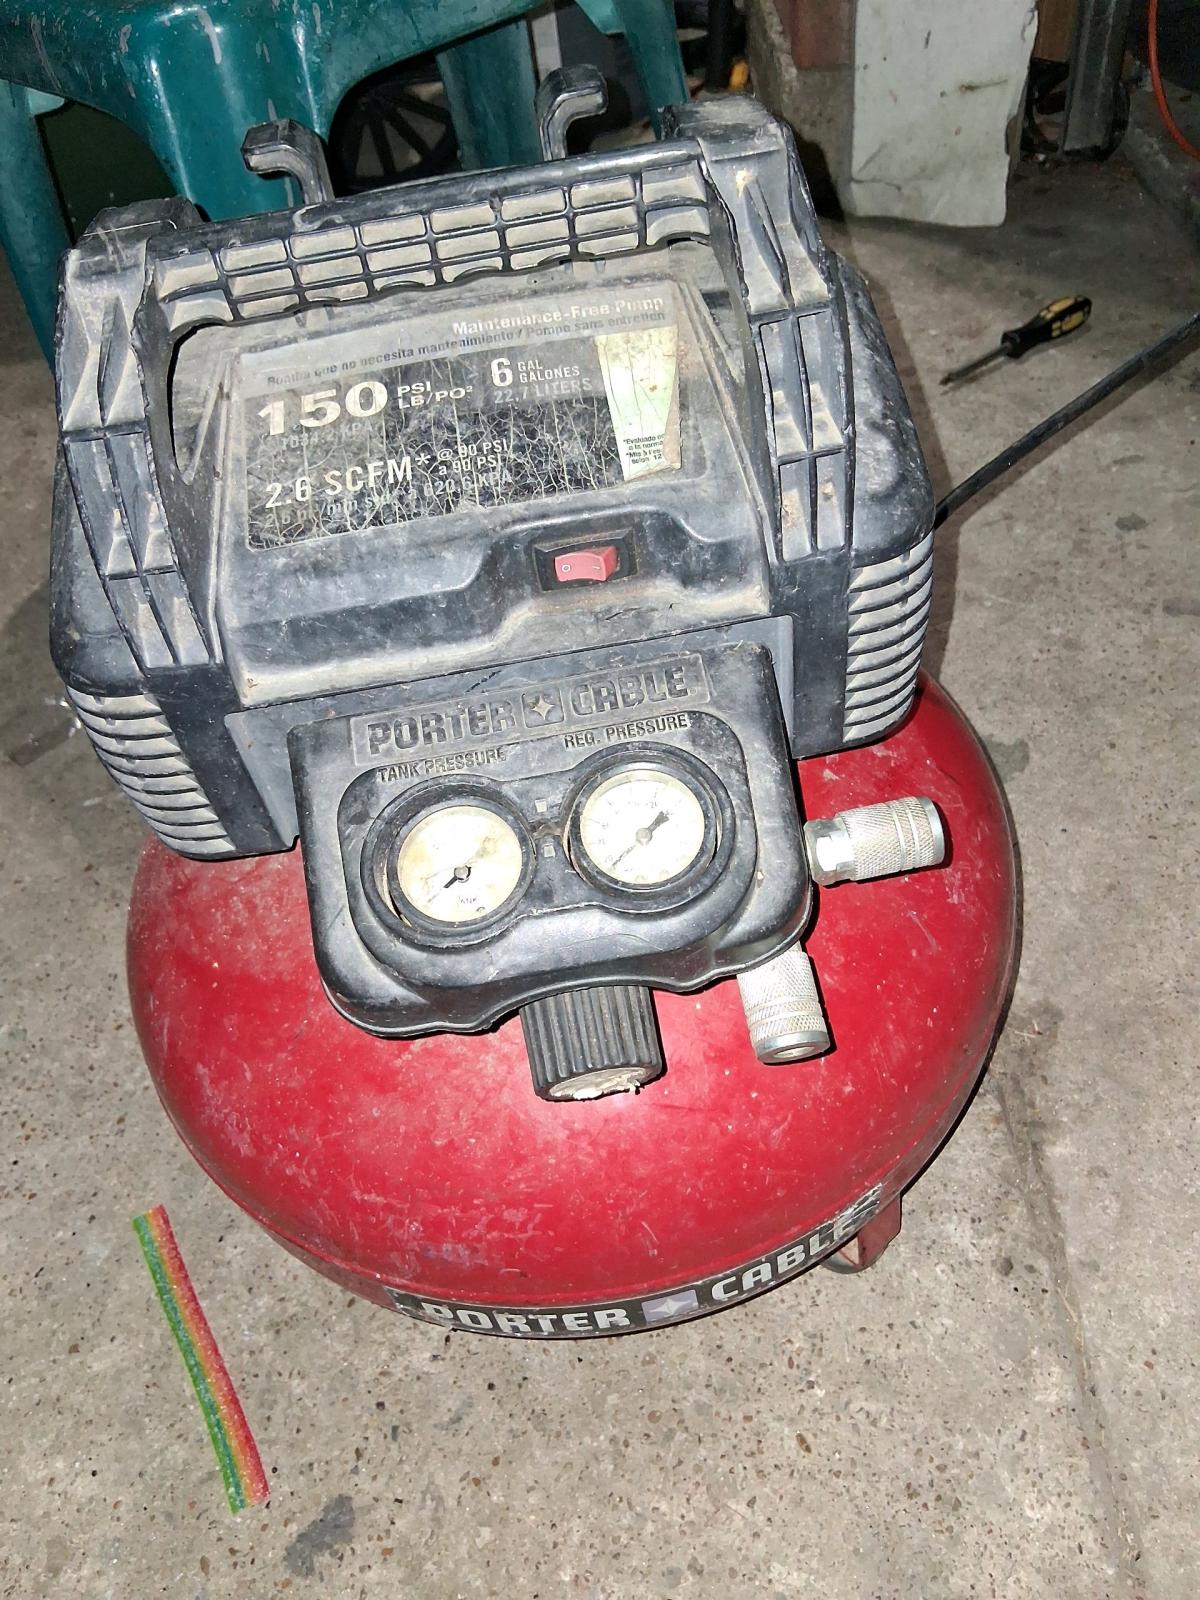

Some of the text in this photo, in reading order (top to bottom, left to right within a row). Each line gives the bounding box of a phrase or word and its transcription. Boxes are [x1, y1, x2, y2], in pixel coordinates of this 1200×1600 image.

[452, 297, 663, 335] Maintenance-Free Pump
[314, 366, 337, 378] que
[342, 361, 357, 370] no
[360, 350, 414, 366] necesita
[418, 330, 513, 355] mantenimiento
[527, 324, 571, 336] Pompe
[574, 318, 605, 331] sans
[607, 311, 665, 327] entretien
[491, 357, 513, 387] 6
[518, 359, 543, 372] GAL
[519, 365, 580, 384] GALONES
[397, 380, 431, 396] PSI
[534, 377, 593, 398] LITERS
[257, 381, 388, 436] 150
[437, 439, 508, 461] @ 90 PSI
[453, 458, 472, 473] 90
[477, 454, 501, 469] PSI
[265, 476, 311, 508] 2.6
[479, 469, 513, 487] KPA
[367, 665, 691, 755] PORTER CABLE
[564, 713, 689, 750] REG. PRESSURE
[376, 748, 507, 783] TANK PRESSURE
[420, 1205, 860, 1335] PORTER CABLE
